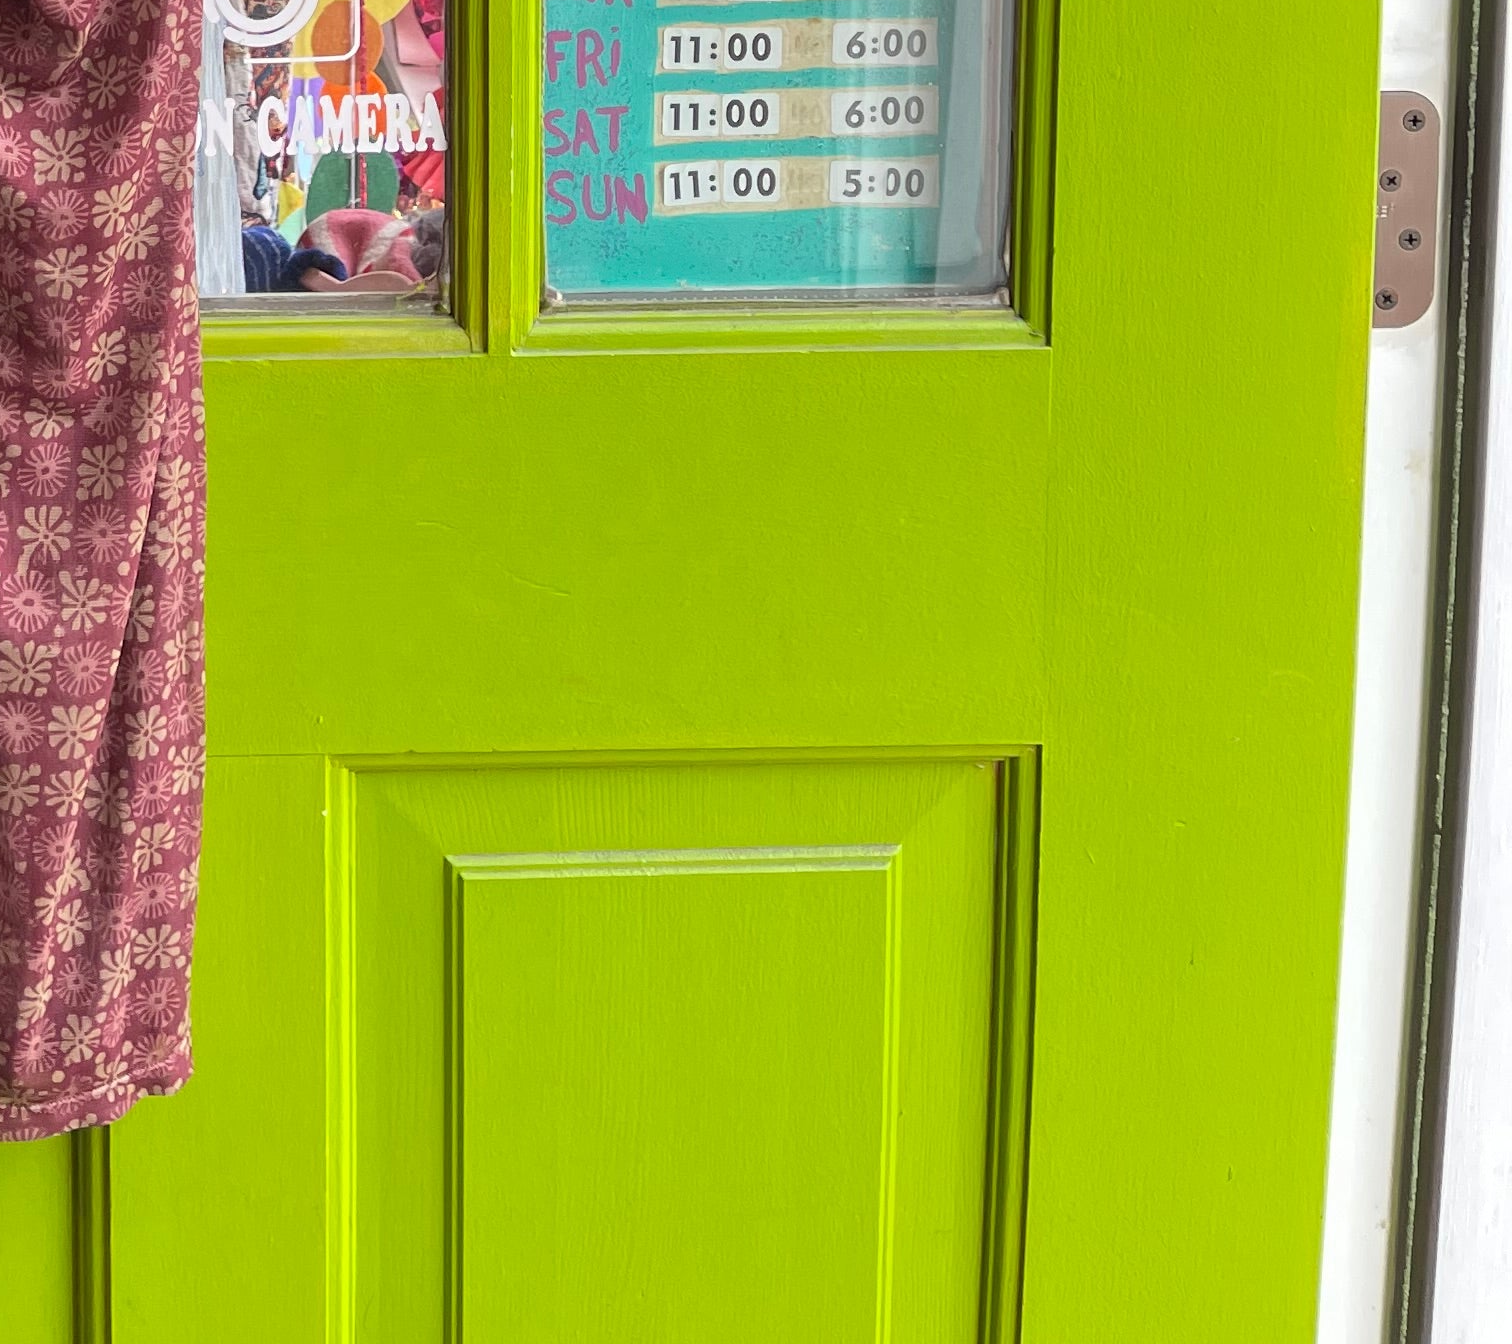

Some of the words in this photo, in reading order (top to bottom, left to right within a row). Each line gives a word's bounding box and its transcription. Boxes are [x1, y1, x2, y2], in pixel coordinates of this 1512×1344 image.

[670, 32, 772, 64] 11:00
[846, 28, 927, 59] 6:00
[196, 97, 236, 157] N
[257, 92, 449, 157] CAMERA
[543, 105, 630, 157] SAT
[669, 98, 770, 131] 11:00
[845, 95, 925, 128] 6:00
[546, 169, 649, 225] SUN
[842, 167, 925, 198] 5:00
